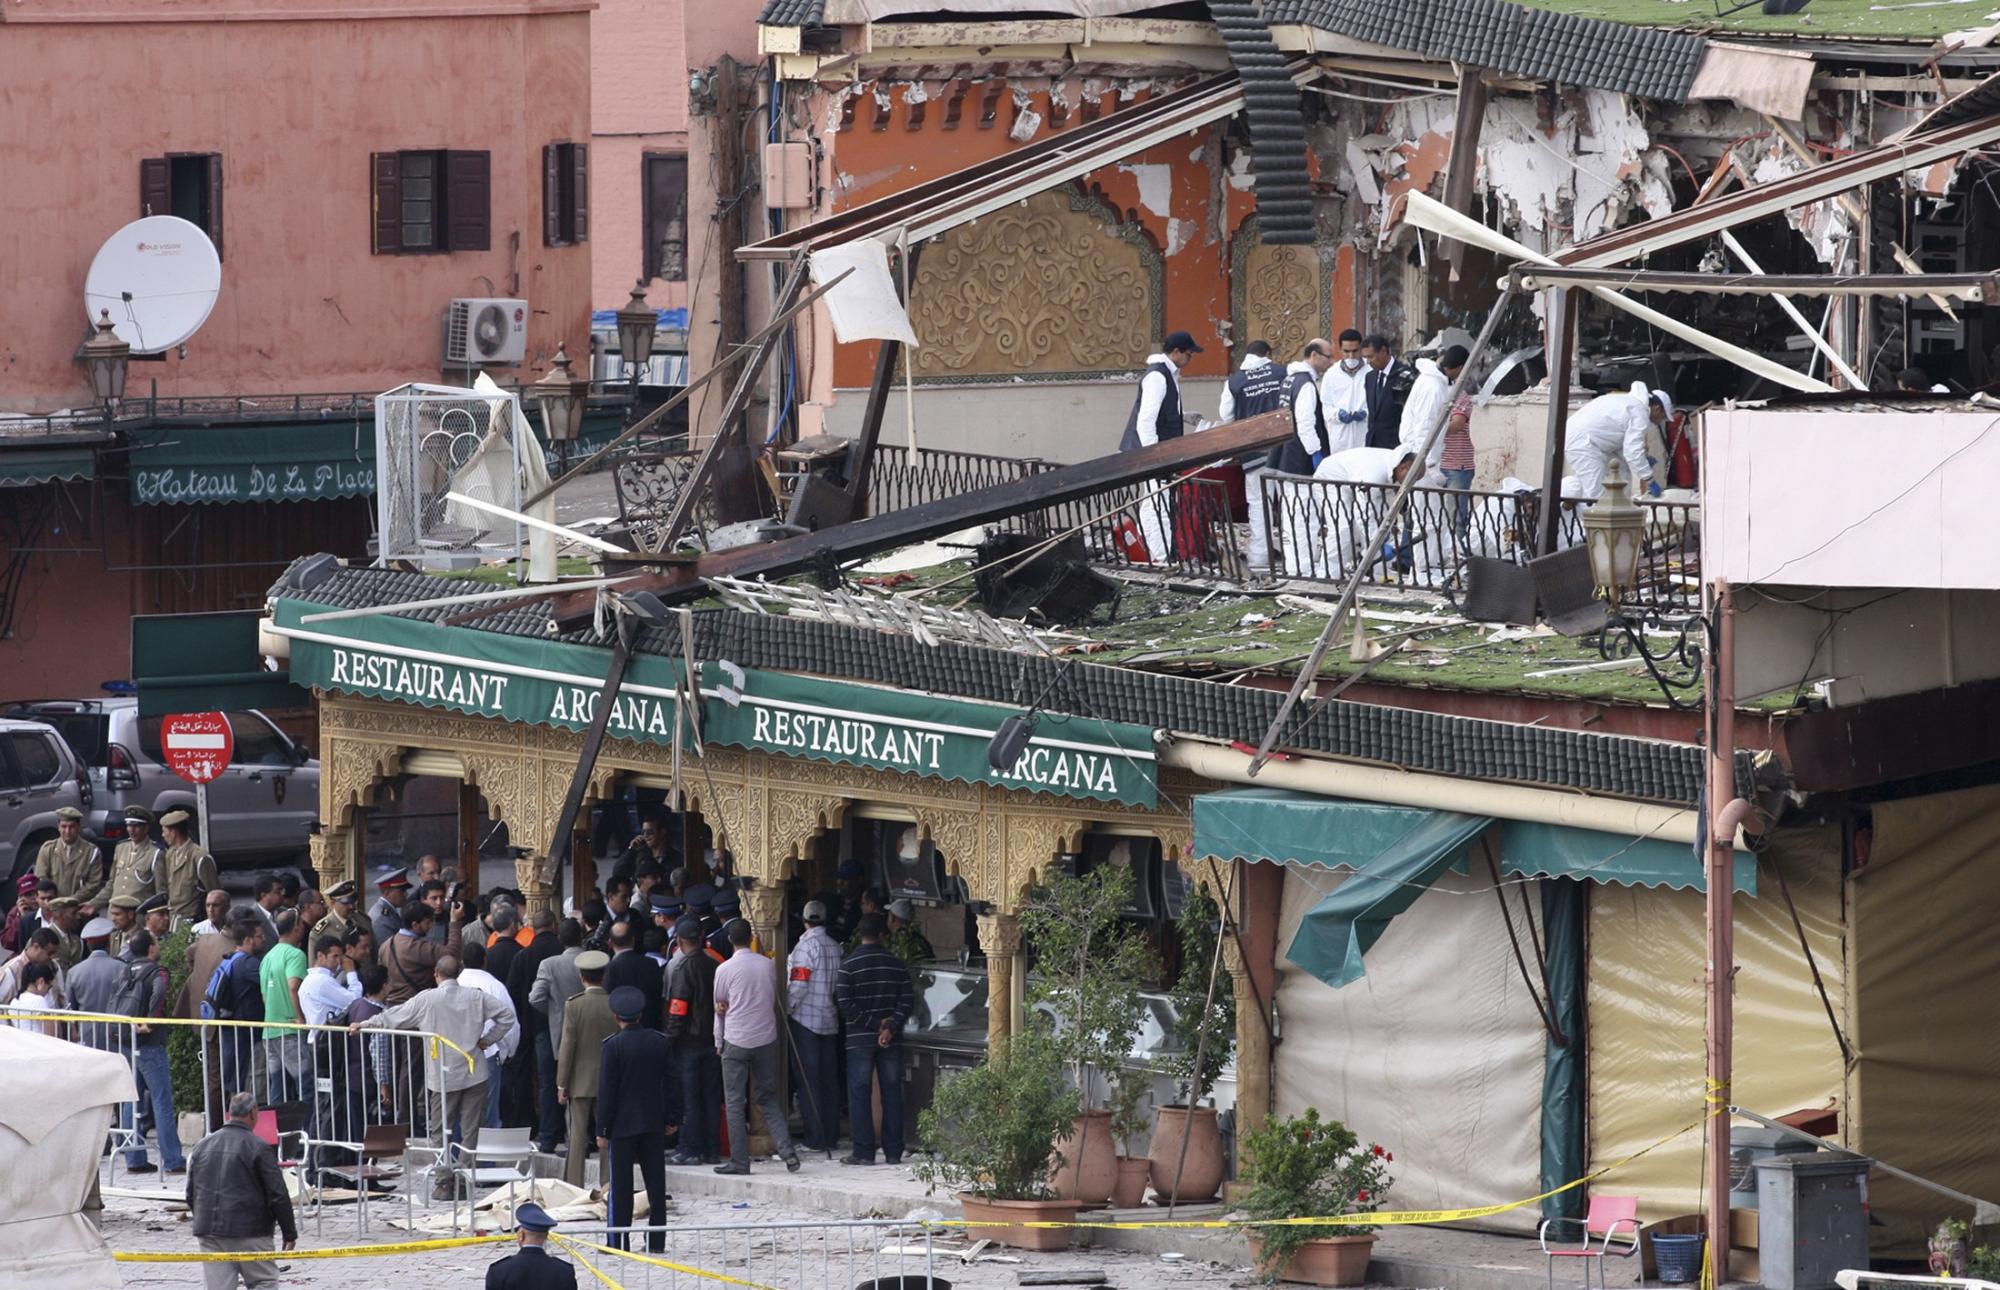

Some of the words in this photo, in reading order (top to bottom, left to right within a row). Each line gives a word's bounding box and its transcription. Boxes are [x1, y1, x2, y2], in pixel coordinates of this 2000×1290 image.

[249, 464, 277, 496] De
[283, 465, 307, 493] La
[330, 649, 508, 710] RESTAURANT
[752, 706, 945, 769] RESTAURANT
[990, 747, 1118, 793] RGANA
